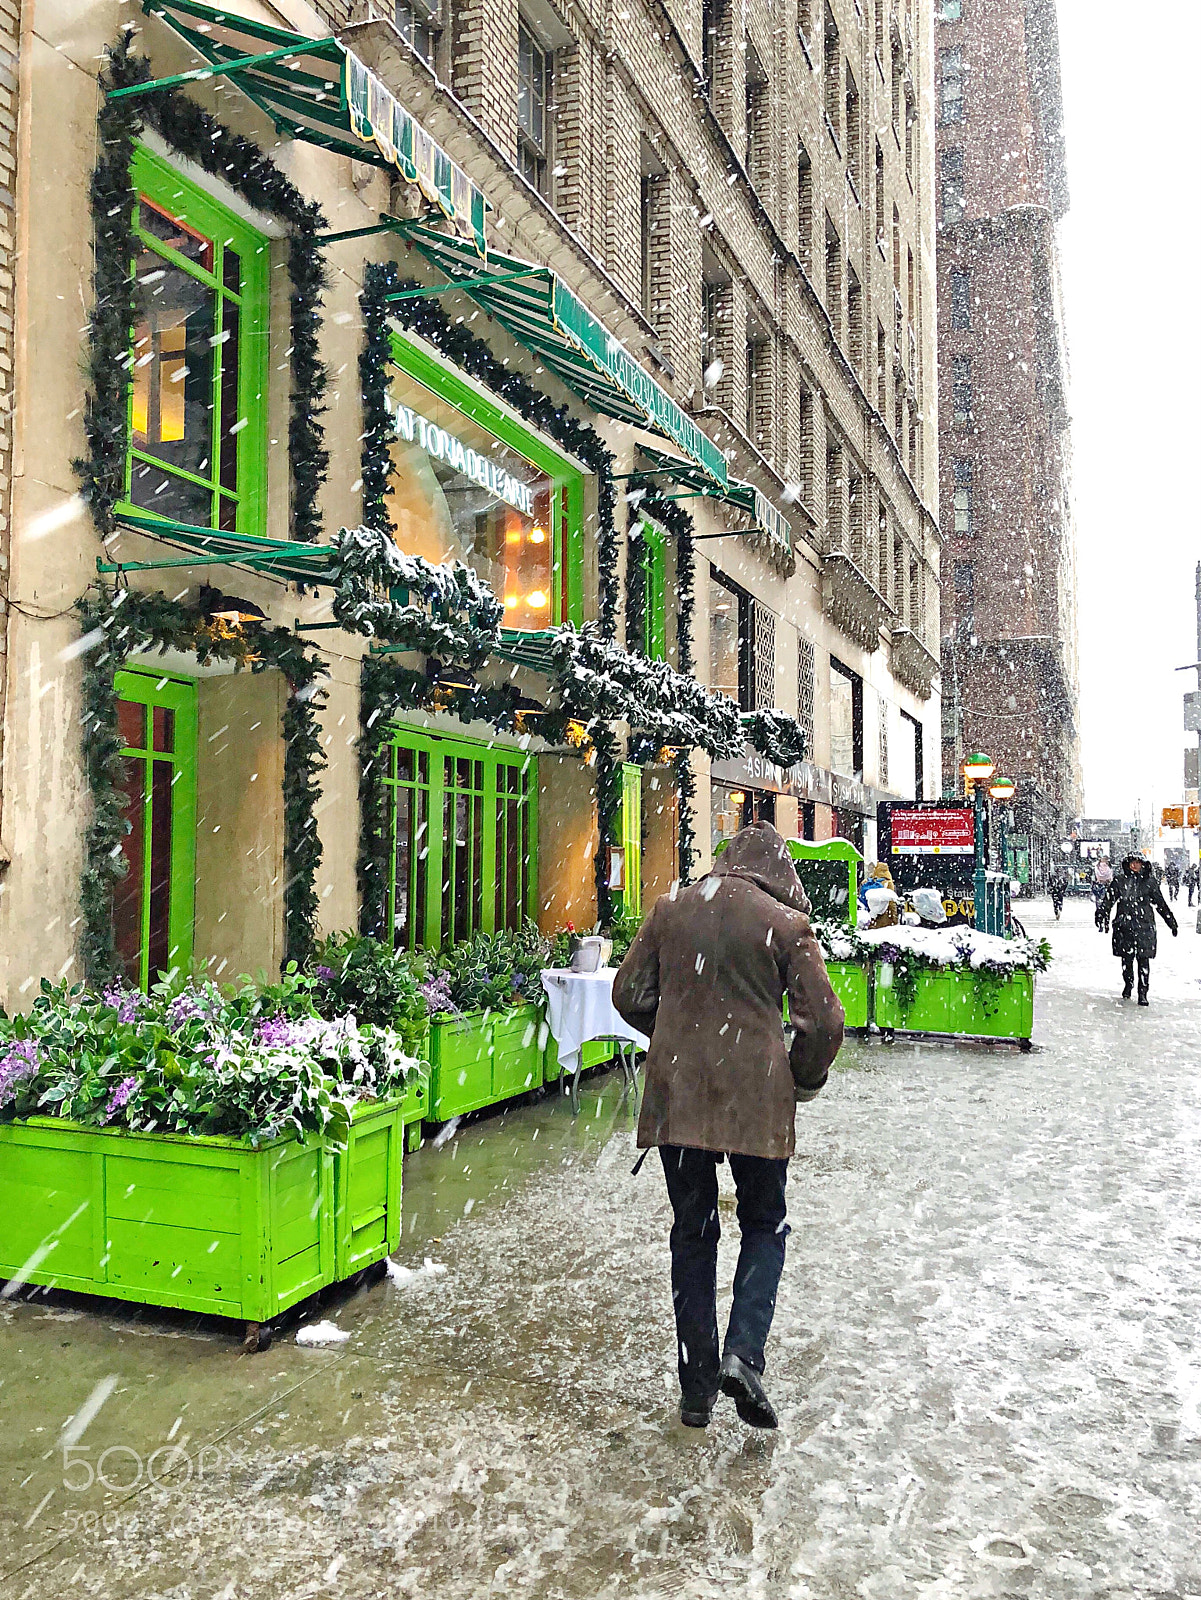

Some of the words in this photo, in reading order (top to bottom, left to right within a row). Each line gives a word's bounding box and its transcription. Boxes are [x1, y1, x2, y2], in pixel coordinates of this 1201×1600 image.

[384, 388, 467, 475] ATTORIA
[747, 756, 777, 784] ASIAN
[946, 888, 975, 898] Statio
[946, 903, 953, 913] R
